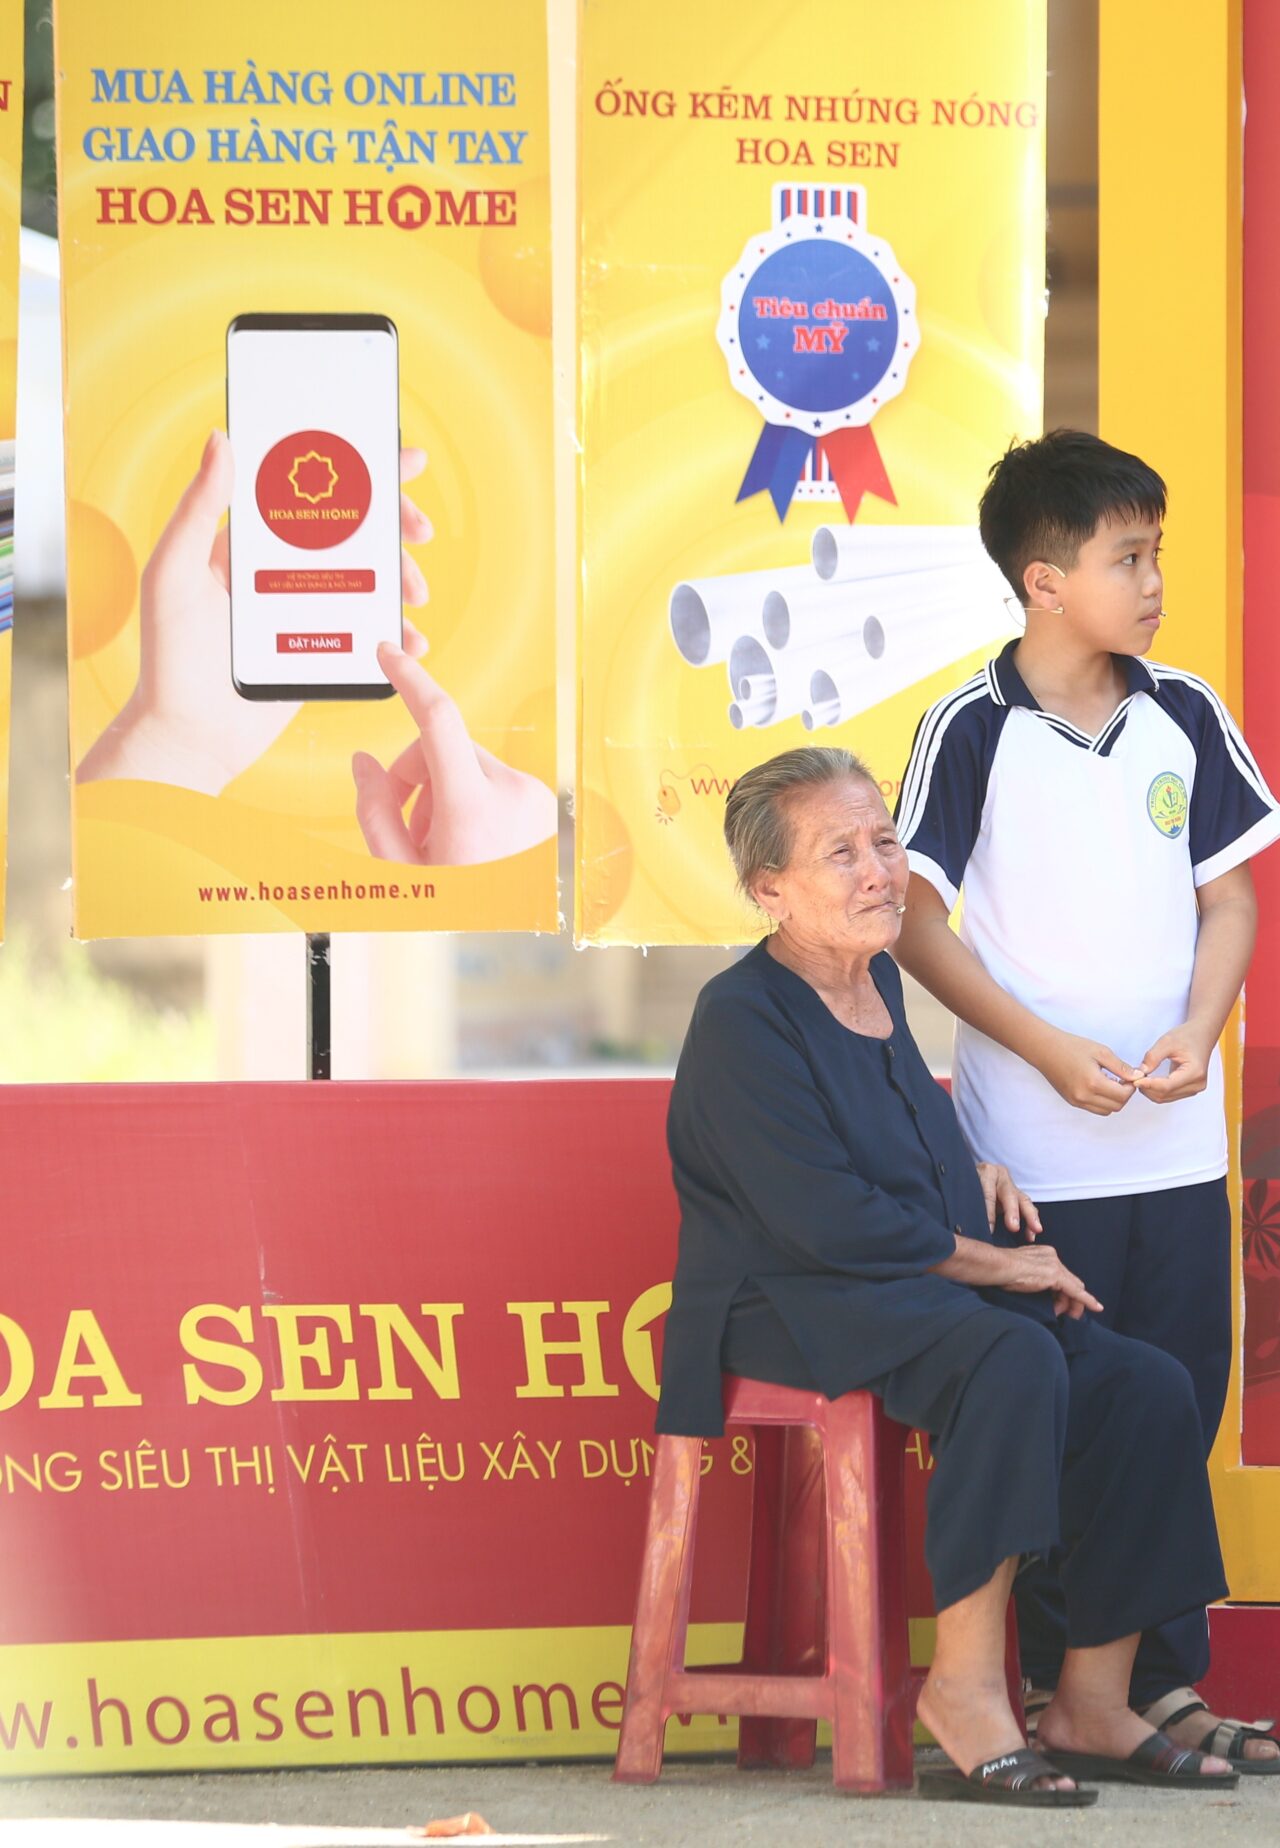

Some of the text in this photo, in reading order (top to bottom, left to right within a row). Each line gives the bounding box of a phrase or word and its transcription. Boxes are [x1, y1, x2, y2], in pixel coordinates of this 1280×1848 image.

[91, 60, 517, 107] MUA HÀNG ONLINE
[595, 77, 1038, 128] ỐNG KẼM NHÚNG NÓNG
[82, 118, 528, 173] GIAO HÀNG TẬN TAY
[736, 137, 900, 168] HOA SEN
[96, 184, 517, 230] HOA SEN HOME
[753, 296, 809, 319] Tiêu
[269, 508, 295, 520] HOA
[296, 508, 319, 520] SEN
[199, 880, 436, 902] www.hoasenhome.vn
[179, 1303, 465, 1407] SEN
[98, 1438, 191, 1491] SIÊU
[205, 1445, 276, 1495] THỊ
[286, 1433, 369, 1493] VẬT
[385, 1432, 465, 1491] LIỆU
[479, 1430, 562, 1481] XÂY
